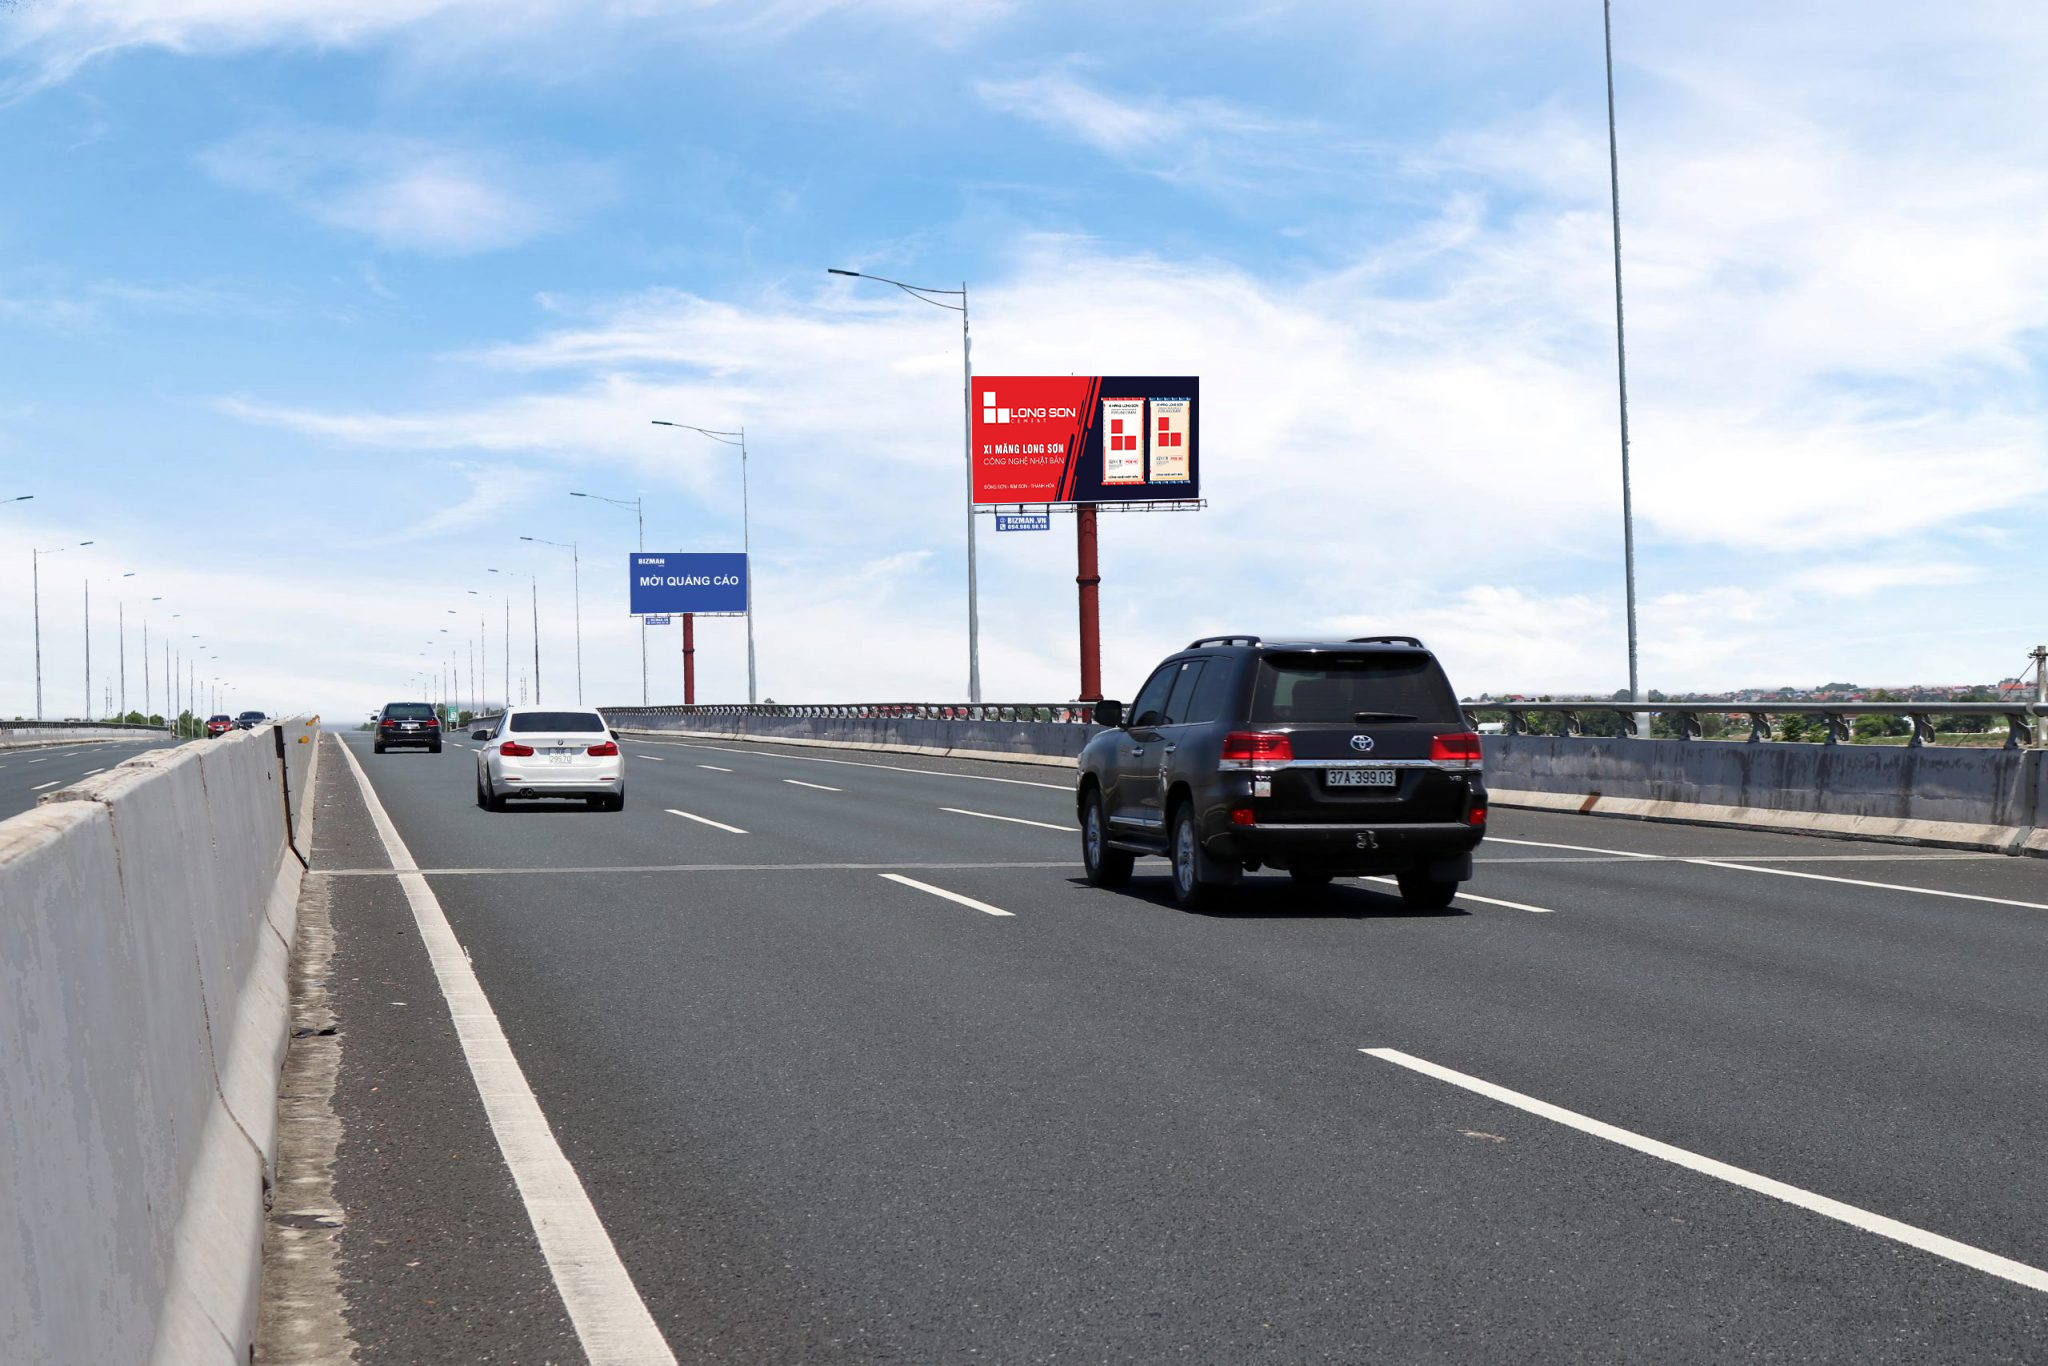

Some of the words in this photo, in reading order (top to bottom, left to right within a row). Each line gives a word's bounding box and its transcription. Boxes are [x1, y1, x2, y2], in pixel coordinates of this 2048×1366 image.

[1010, 408, 1046, 417] LONG
[1048, 407, 1076, 417] SON
[983, 444, 992, 454] XI
[995, 442, 1020, 454] MĂNG
[1023, 443, 1044, 454] LONG
[983, 456, 1007, 466] CÔNG
[1008, 456, 1028, 466] NGHỆ
[1030, 456, 1048, 466] NHẬT
[1049, 455, 1065, 464] BẢN
[640, 574, 664, 586] MỜI
[667, 574, 710, 586] QUẢNG
[713, 574, 739, 586] CÁO
[1329, 771, 1394, 784] 37A-399.03
